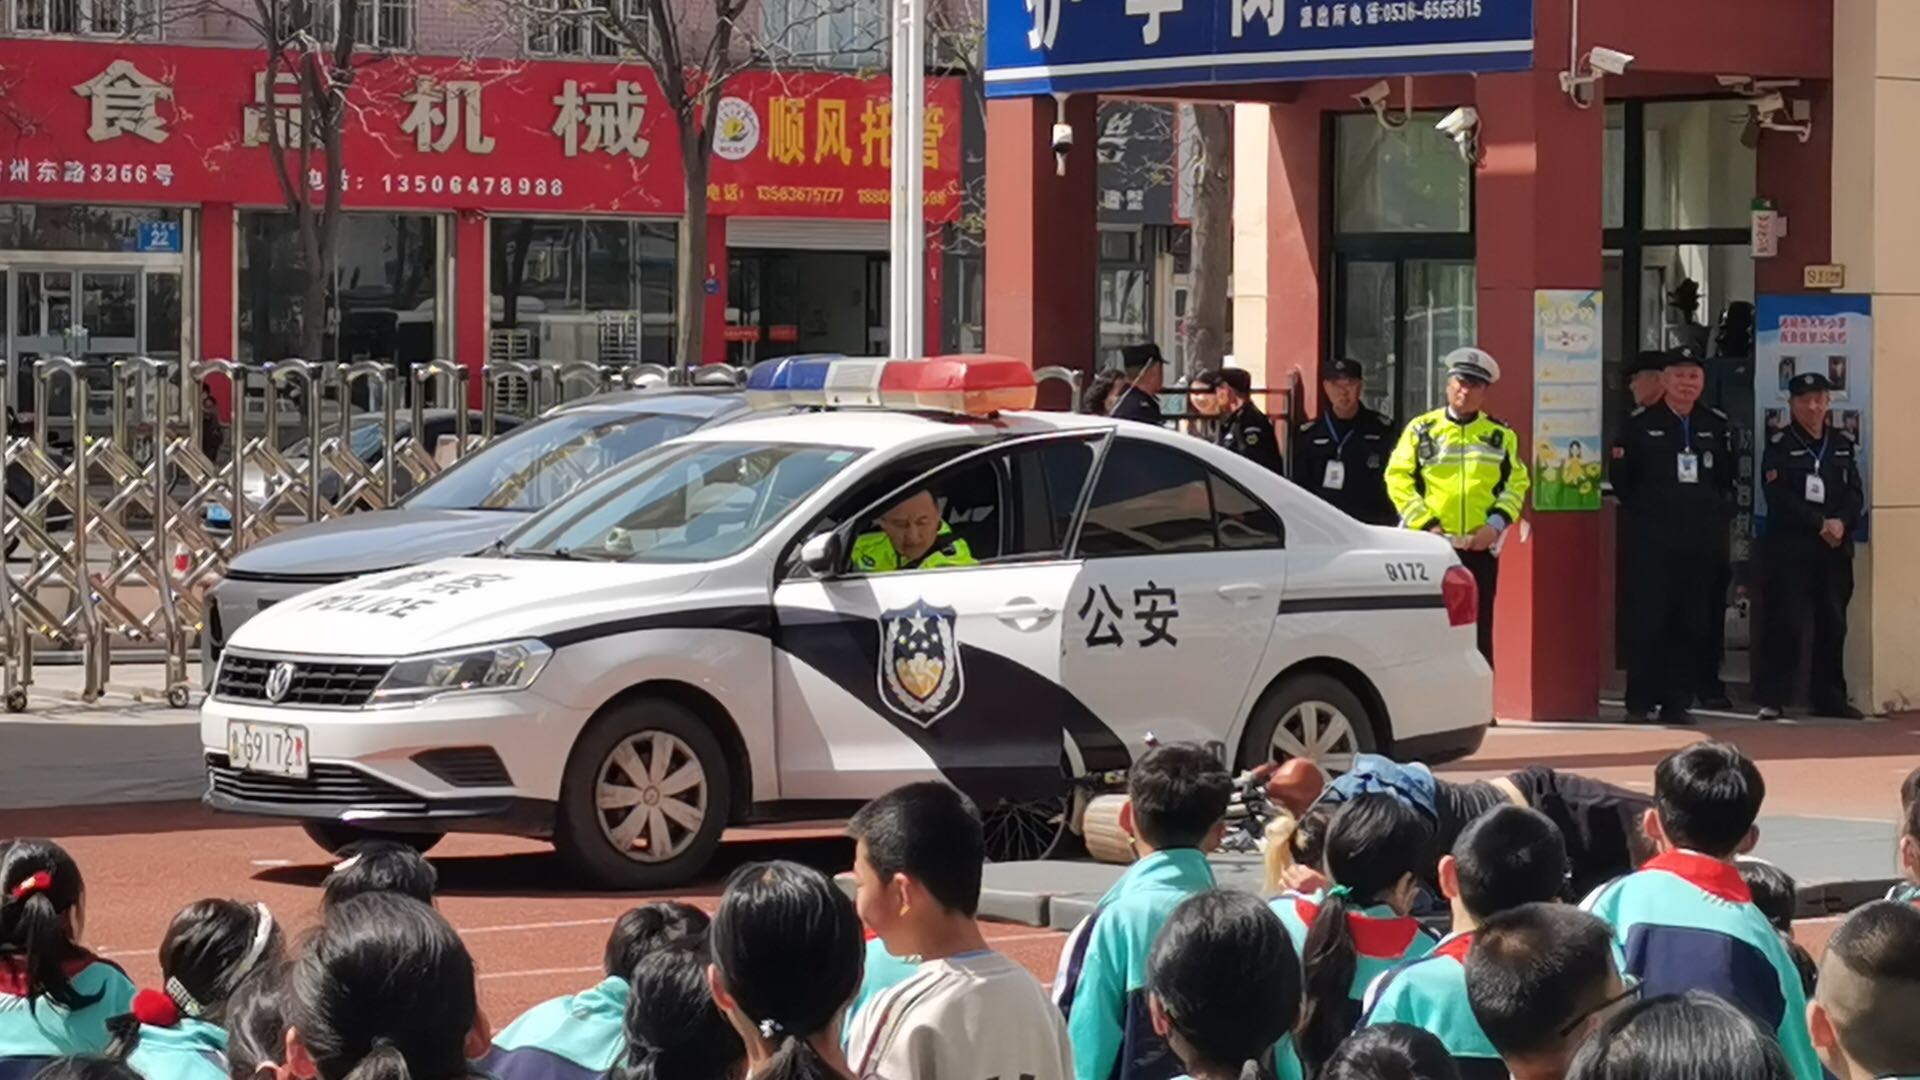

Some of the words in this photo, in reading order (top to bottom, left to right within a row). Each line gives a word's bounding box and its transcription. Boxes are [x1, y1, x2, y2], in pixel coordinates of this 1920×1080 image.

[0, 158, 175, 187] 州东路3366号
[381, 173, 564, 197] 13506478988
[1385, 562, 1430, 582] 9172
[300, 594, 436, 619] POLICE
[1079, 581, 1179, 649] 公安
